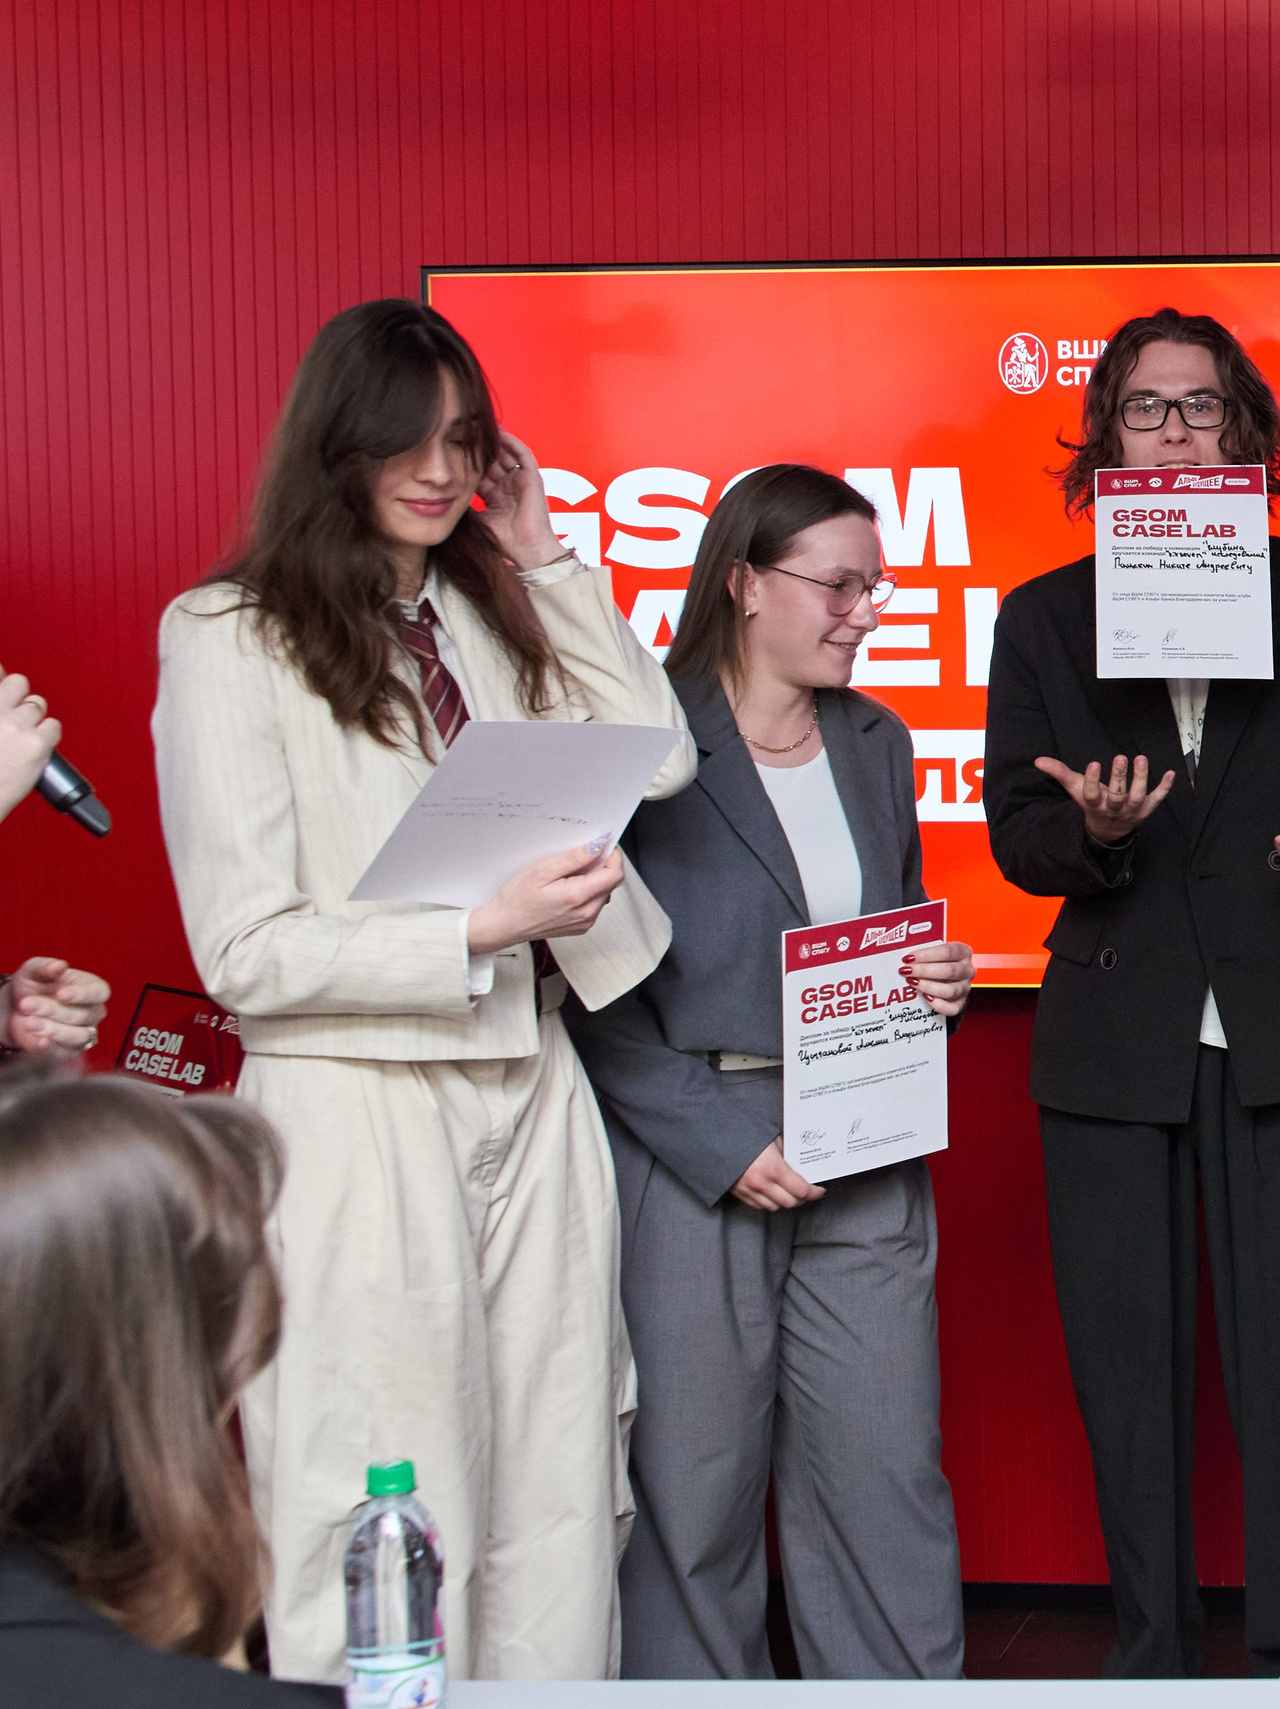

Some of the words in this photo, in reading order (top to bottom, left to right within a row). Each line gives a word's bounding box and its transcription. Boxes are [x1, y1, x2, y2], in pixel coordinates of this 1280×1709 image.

[538, 467, 971, 569] GSM
[1112, 509, 1188, 522] GSOM
[1112, 523, 1183, 538] CASE
[1186, 524, 1237, 538] LAB
[801, 975, 874, 1005] GSOM
[801, 995, 869, 1025] CASE
[871, 985, 918, 1010] LAB
[133, 1026, 185, 1056] GSOM
[125, 1049, 173, 1078] CASE
[168, 1059, 206, 1086] LAB
